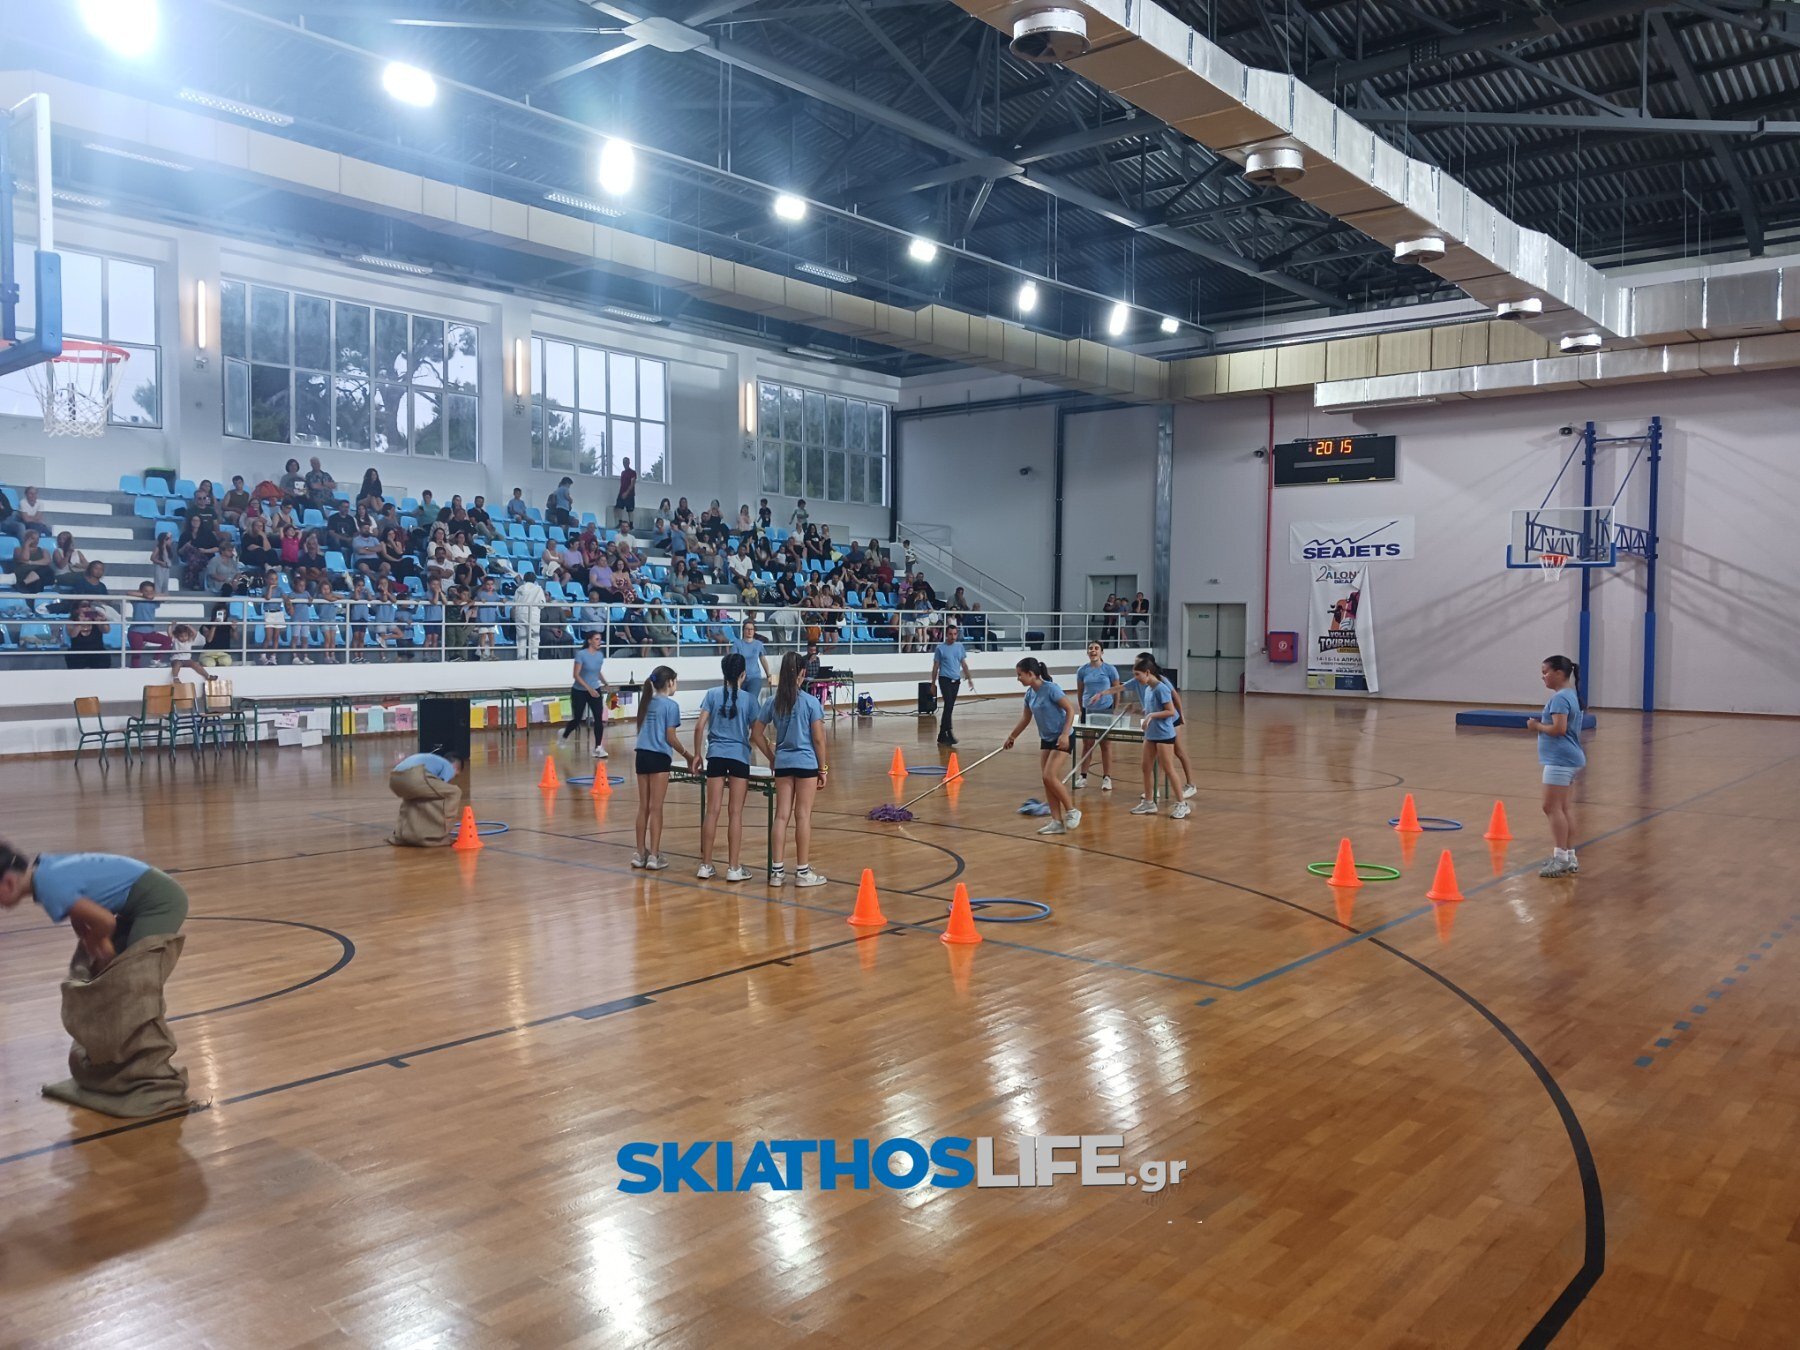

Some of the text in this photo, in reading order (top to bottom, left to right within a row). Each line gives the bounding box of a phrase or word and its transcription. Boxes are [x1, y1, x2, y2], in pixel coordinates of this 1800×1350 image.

[1303, 543, 1400, 559] SEAJETS
[1325, 570, 1360, 580] ALON
[1320, 638, 1358, 651] TOURNA
